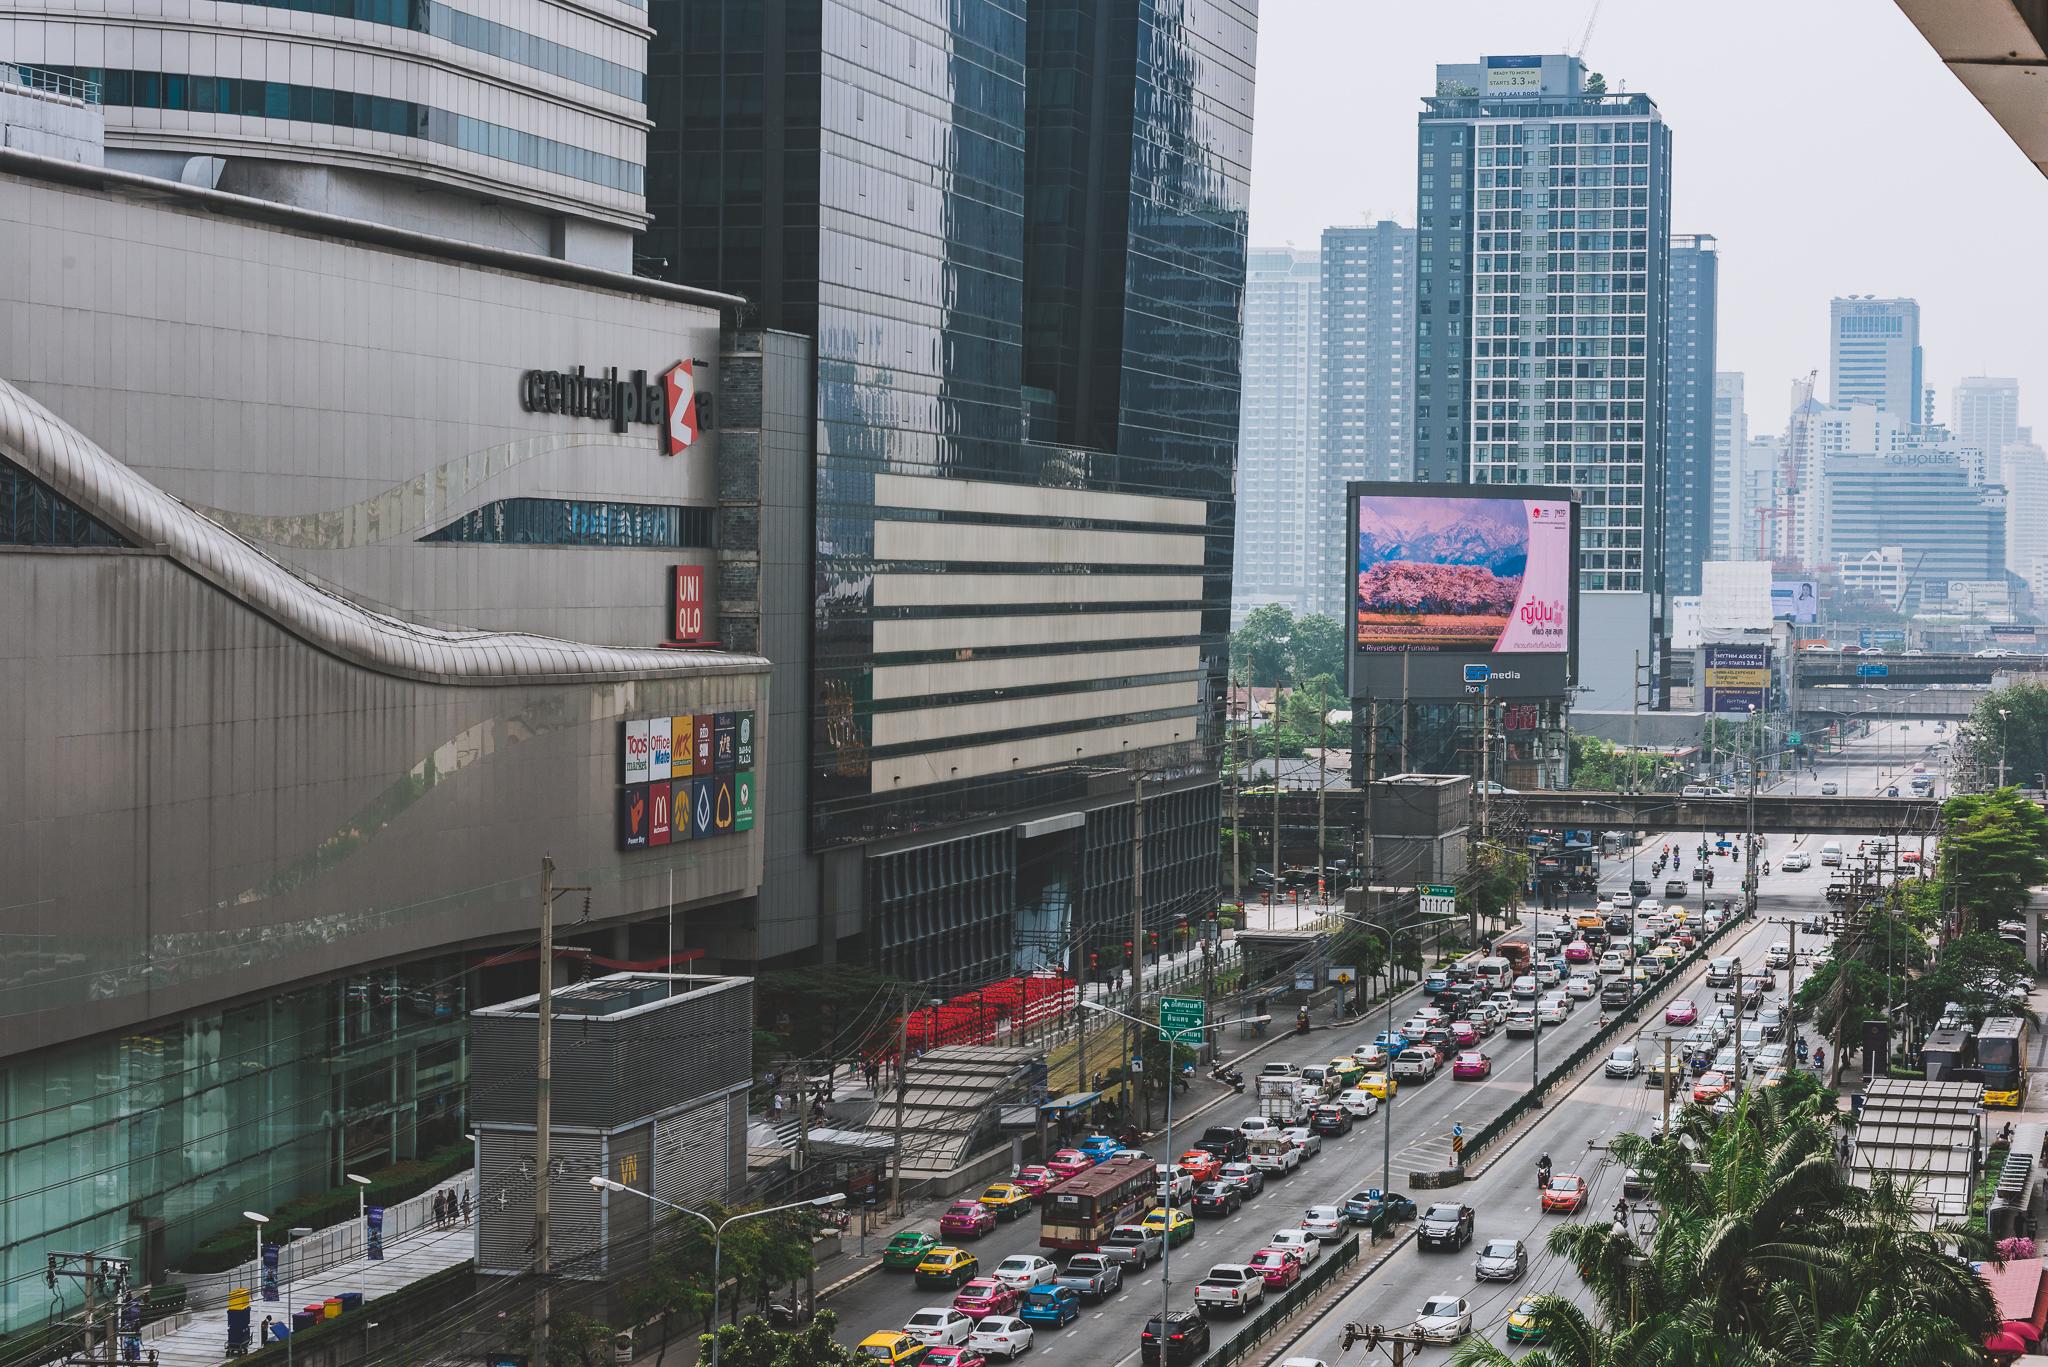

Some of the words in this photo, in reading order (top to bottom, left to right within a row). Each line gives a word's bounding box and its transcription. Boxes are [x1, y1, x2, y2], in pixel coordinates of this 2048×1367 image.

[1511, 77, 1526, 85] 3.3
[680, 575, 699, 602] UNI
[679, 608, 700, 638] QLO
[1366, 644, 1397, 652] Riverside
[1490, 671, 1520, 679] media
[627, 735, 648, 759] Tops
[651, 735, 670, 751] Office
[626, 759, 647, 771] market
[655, 749, 670, 765] Mate
